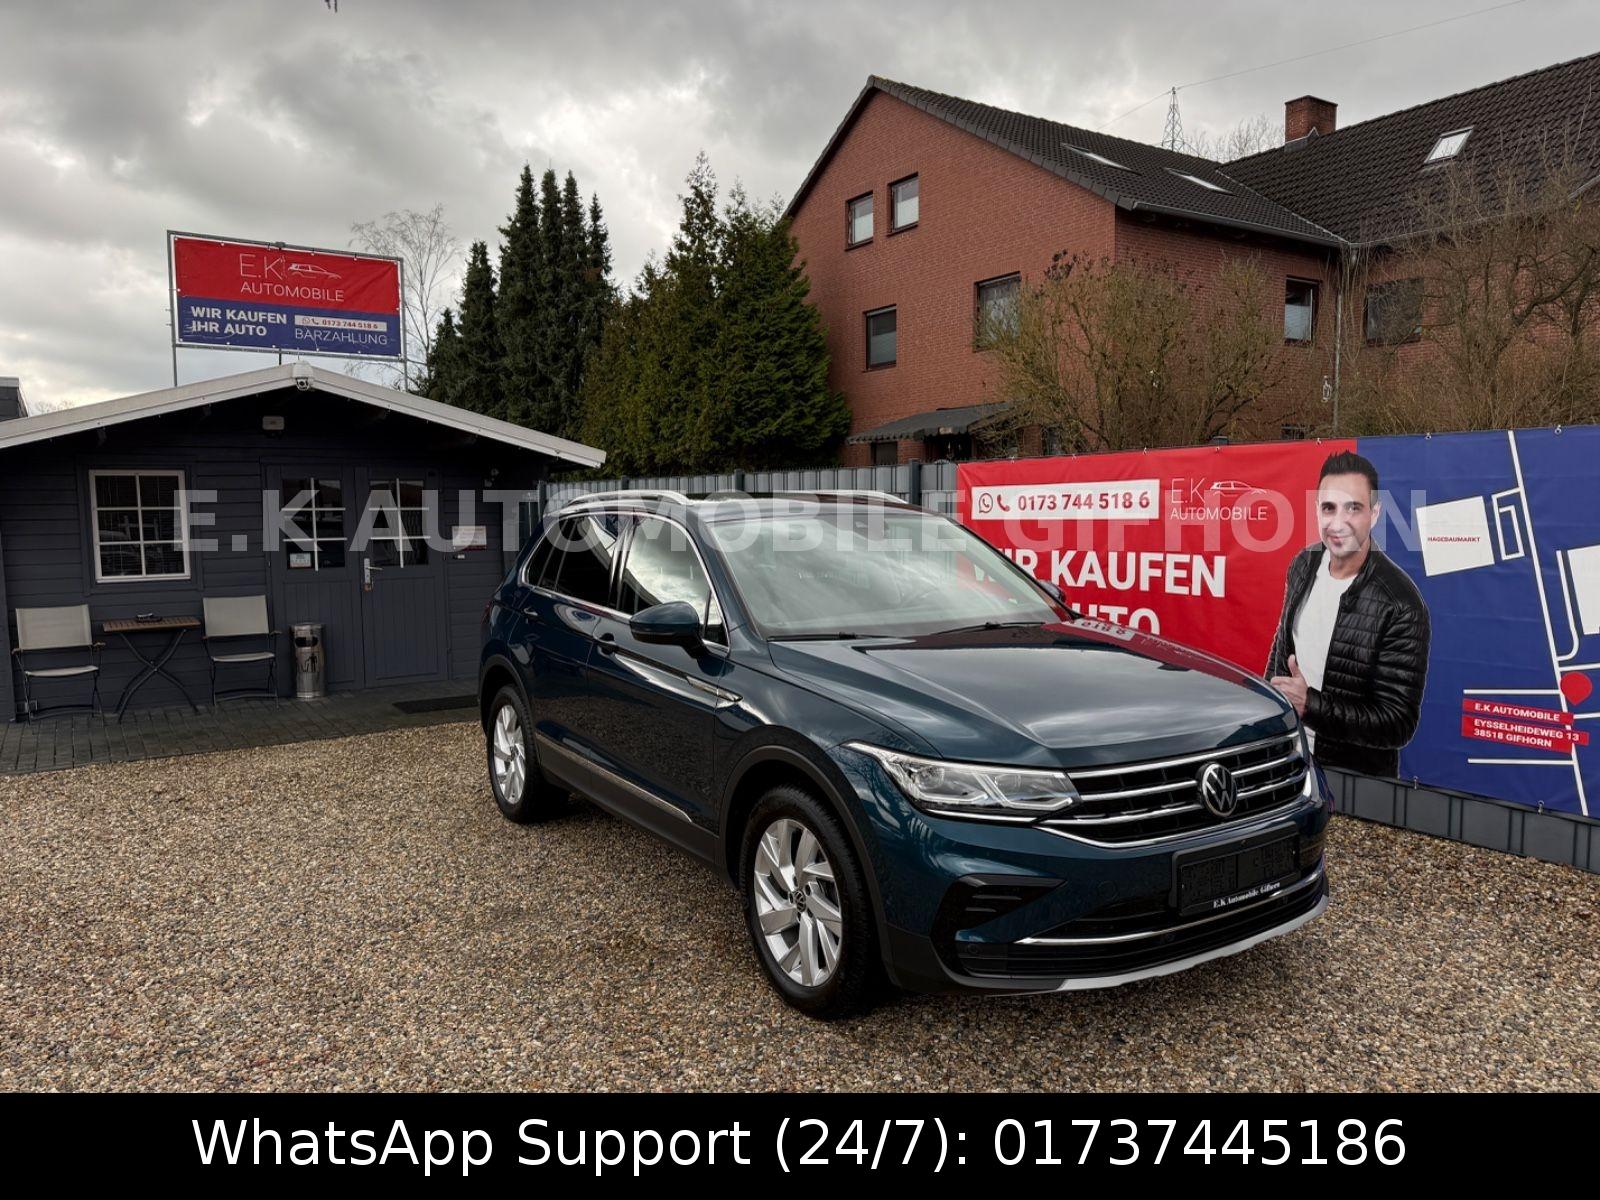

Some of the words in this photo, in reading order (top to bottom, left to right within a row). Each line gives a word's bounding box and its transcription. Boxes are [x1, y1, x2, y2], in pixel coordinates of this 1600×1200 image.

[240, 253, 283, 280] E.K
[240, 281, 345, 302] AUTOMOBILE
[190, 306, 222, 319] WIR
[225, 309, 287, 325] KAUFEN
[322, 319, 341, 327] 0173
[191, 320, 220, 333] IHR
[223, 323, 267, 336] AUTO
[295, 327, 388, 345] BARZAHLUNG
[1170, 478, 1206, 504] E.K
[1018, 493, 1058, 511] 0173
[1061, 493, 1094, 510] 744
[1098, 492, 1134, 509] 518
[1138, 491, 1151, 508] 6
[1170, 506, 1268, 521] AUTOMOBILE
[1051, 549, 1227, 598] KAUFEN
[1474, 703, 1490, 712] E.K
[1492, 706, 1560, 721] AUTOMOBILE
[1474, 719, 1563, 739] EYSSELHEIDEWEG
[1566, 733, 1580, 741] 13
[1474, 729, 1503, 740] 38518
[1506, 734, 1552, 747] GIFHORN
